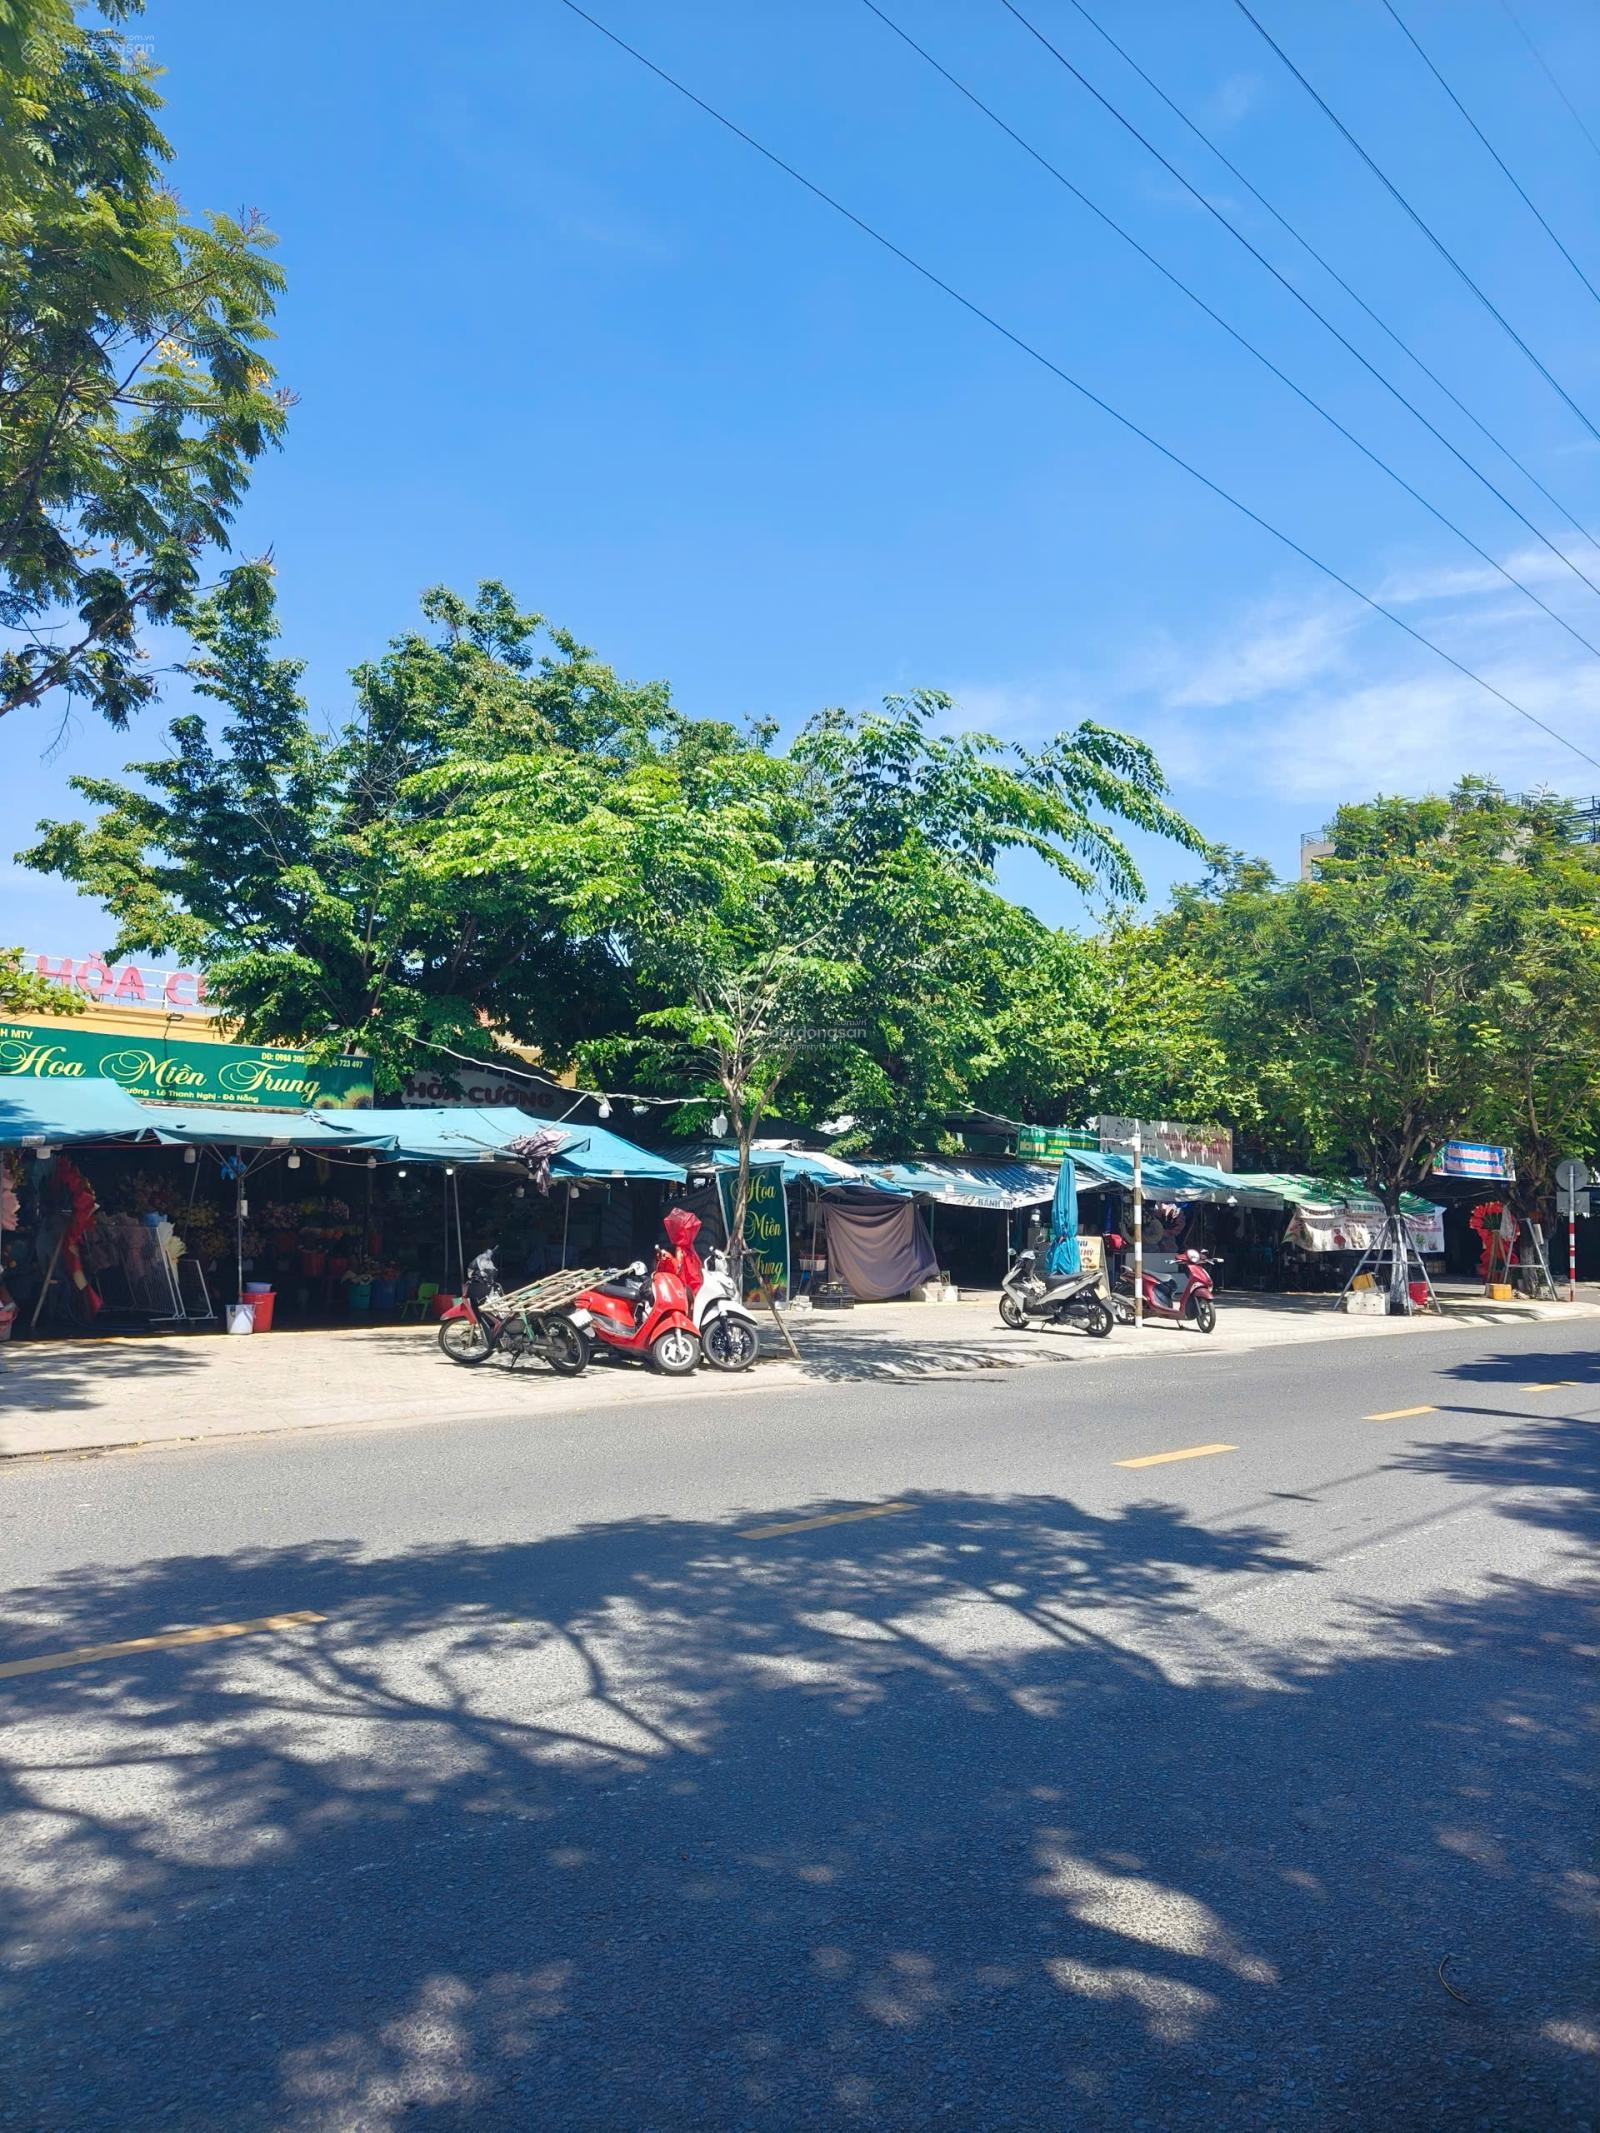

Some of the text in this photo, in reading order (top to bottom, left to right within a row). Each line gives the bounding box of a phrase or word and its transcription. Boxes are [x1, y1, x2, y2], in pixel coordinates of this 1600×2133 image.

[37, 951, 145, 1000] HÒA
[11, 1028, 33, 1040] MTV
[0, 1040, 320, 1104] Hoa Miền Trung
[339, 1059, 351, 1069] 723
[169, 1090, 195, 1099] Thanh
[196, 1092, 216, 1101] Nghị
[222, 1093, 235, 1101] Đà
[468, 1083, 554, 1108] CƯỜNG
[730, 1174, 784, 1285] Hoa Miền Trung
